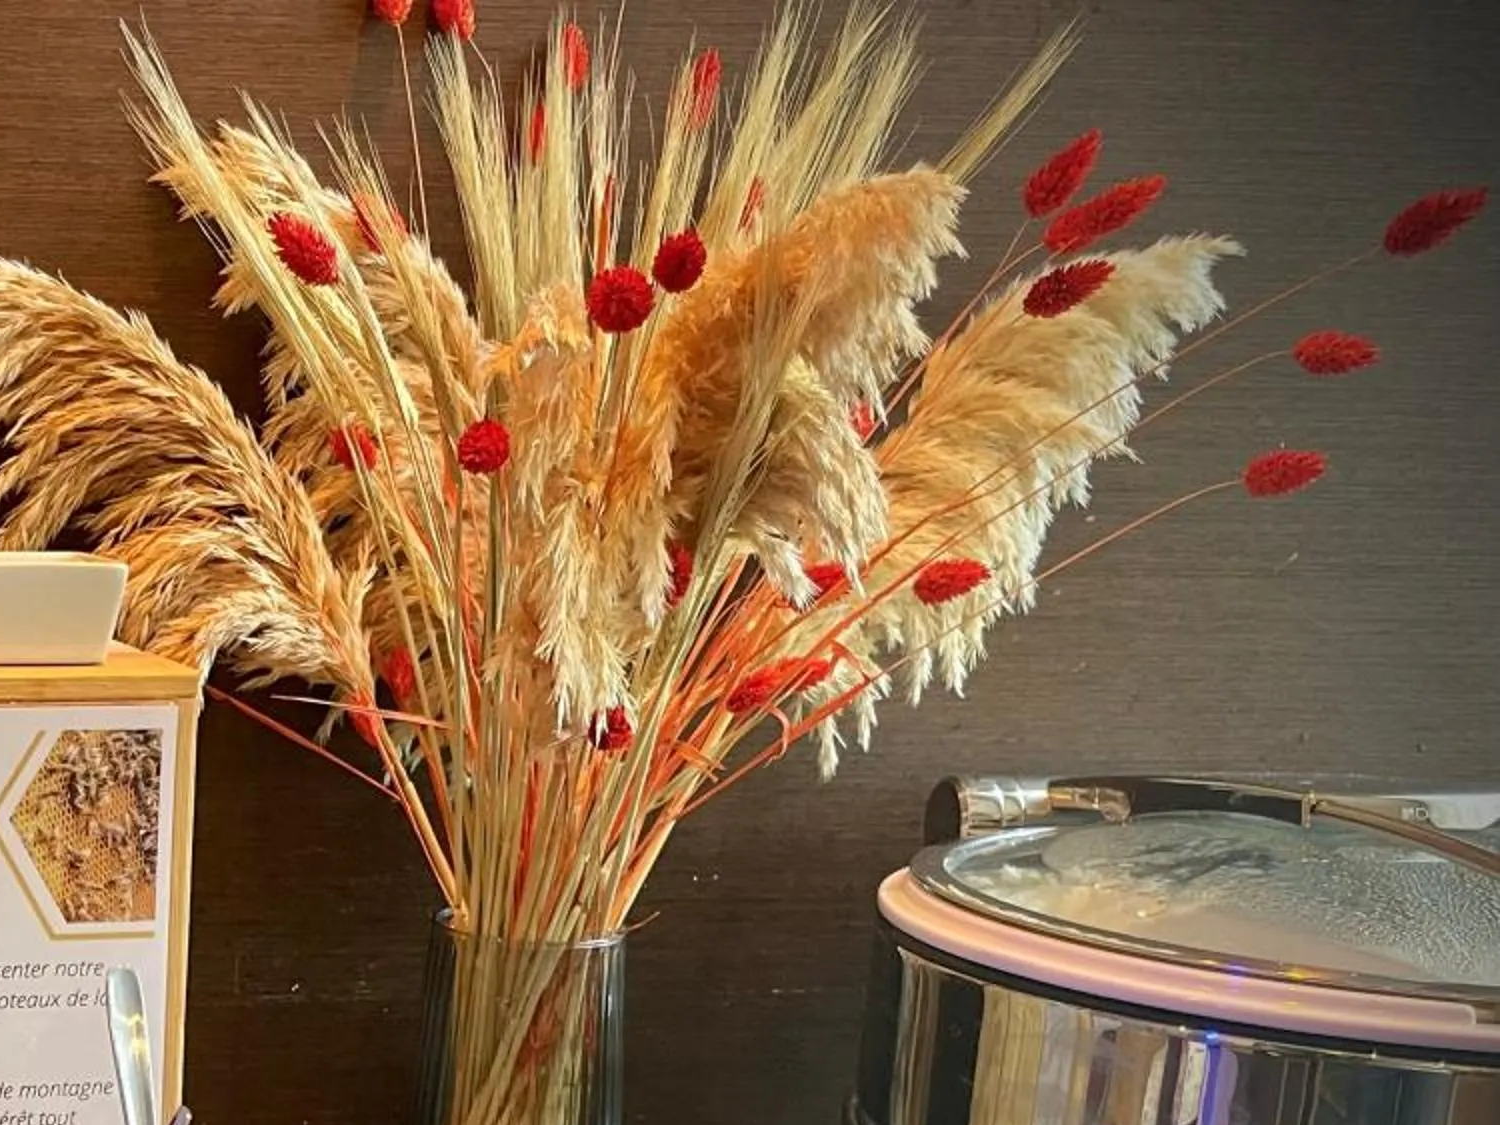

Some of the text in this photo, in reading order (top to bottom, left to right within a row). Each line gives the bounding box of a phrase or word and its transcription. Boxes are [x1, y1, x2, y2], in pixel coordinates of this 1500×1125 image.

[54, 961, 105, 978] notre
[67, 988, 89, 1007] de
[19, 1080, 114, 1101] montagne
